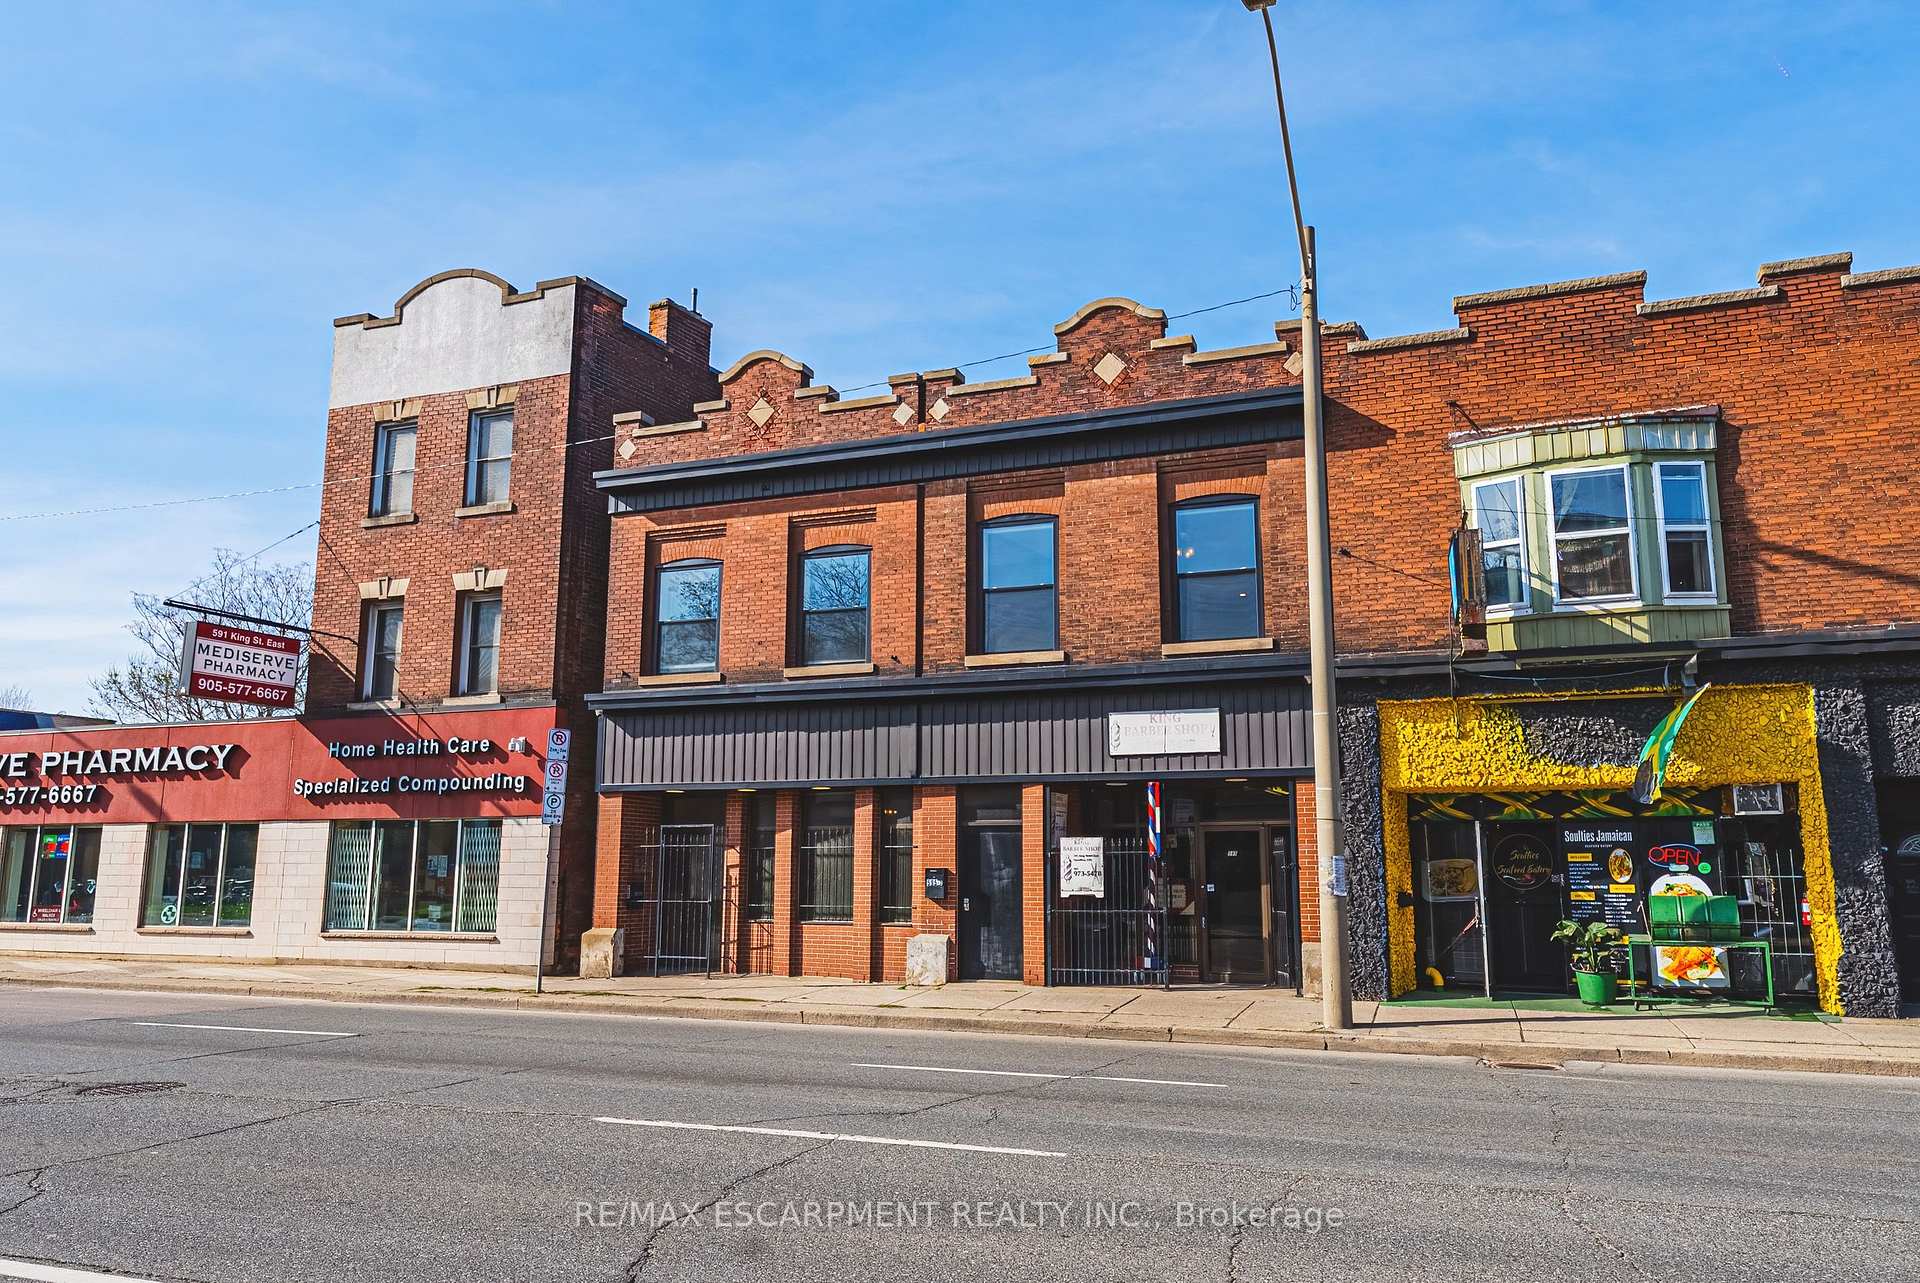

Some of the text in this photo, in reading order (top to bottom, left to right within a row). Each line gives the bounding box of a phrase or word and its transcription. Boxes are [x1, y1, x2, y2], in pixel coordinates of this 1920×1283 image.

[212, 629, 285, 649] 591 King St. East
[197, 643, 295, 670] MEDISERVE
[203, 659, 287, 682] PHARMACY
[198, 678, 288, 701] 905-577-6667
[1150, 713, 1181, 723] KING
[1175, 723, 1209, 735] SHOP
[329, 736, 490, 758] Home Health Care
[40, 744, 234, 776] PHARMACY
[293, 773, 525, 798] Specialized Compounding
[1564, 829, 1633, 842] Soulties Jamaican
[1648, 846, 1700, 866] OPEN
